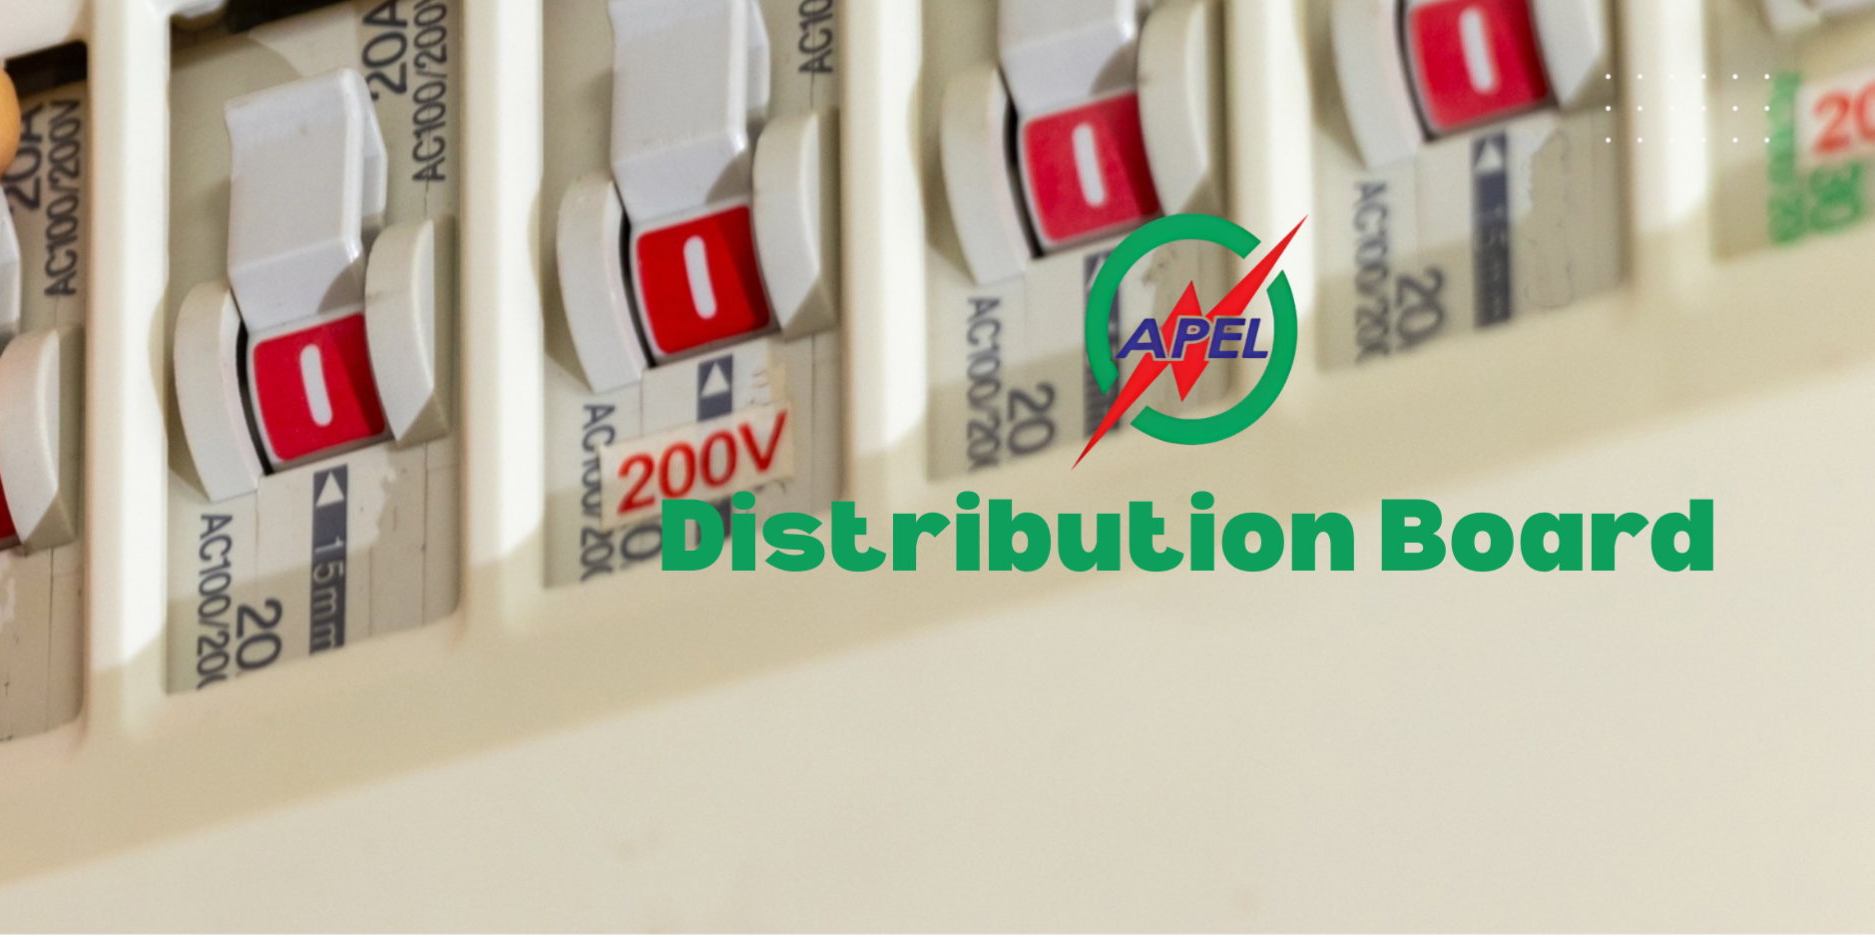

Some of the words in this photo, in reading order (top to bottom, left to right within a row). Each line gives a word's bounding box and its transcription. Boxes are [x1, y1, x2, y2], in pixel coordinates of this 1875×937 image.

[412, 0, 448, 182] AC100/200
[617, 409, 789, 515] 200V
[235, 598, 283, 677] 20
